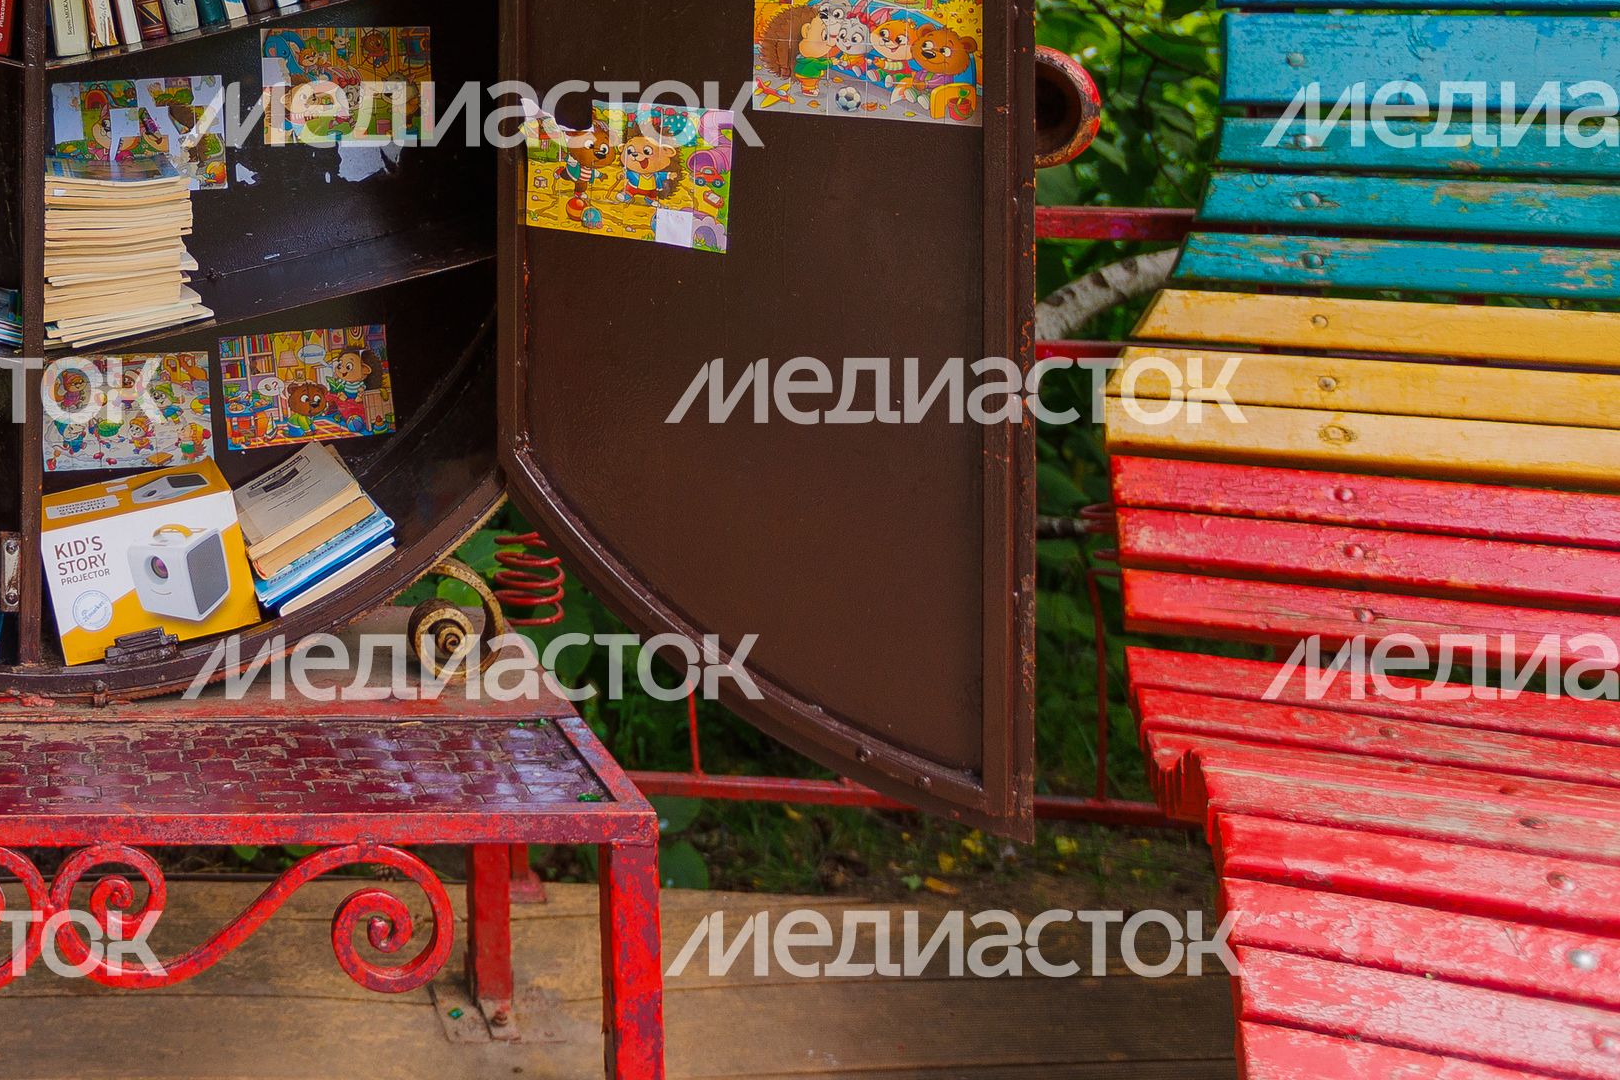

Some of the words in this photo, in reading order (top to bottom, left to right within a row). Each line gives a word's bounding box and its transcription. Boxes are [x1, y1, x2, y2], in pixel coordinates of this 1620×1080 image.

[60, 503, 106, 515] THANKS
[54, 536, 104, 560] KID'S
[57, 553, 108, 576] STORY
[60, 568, 111, 586] PROJECTOR
